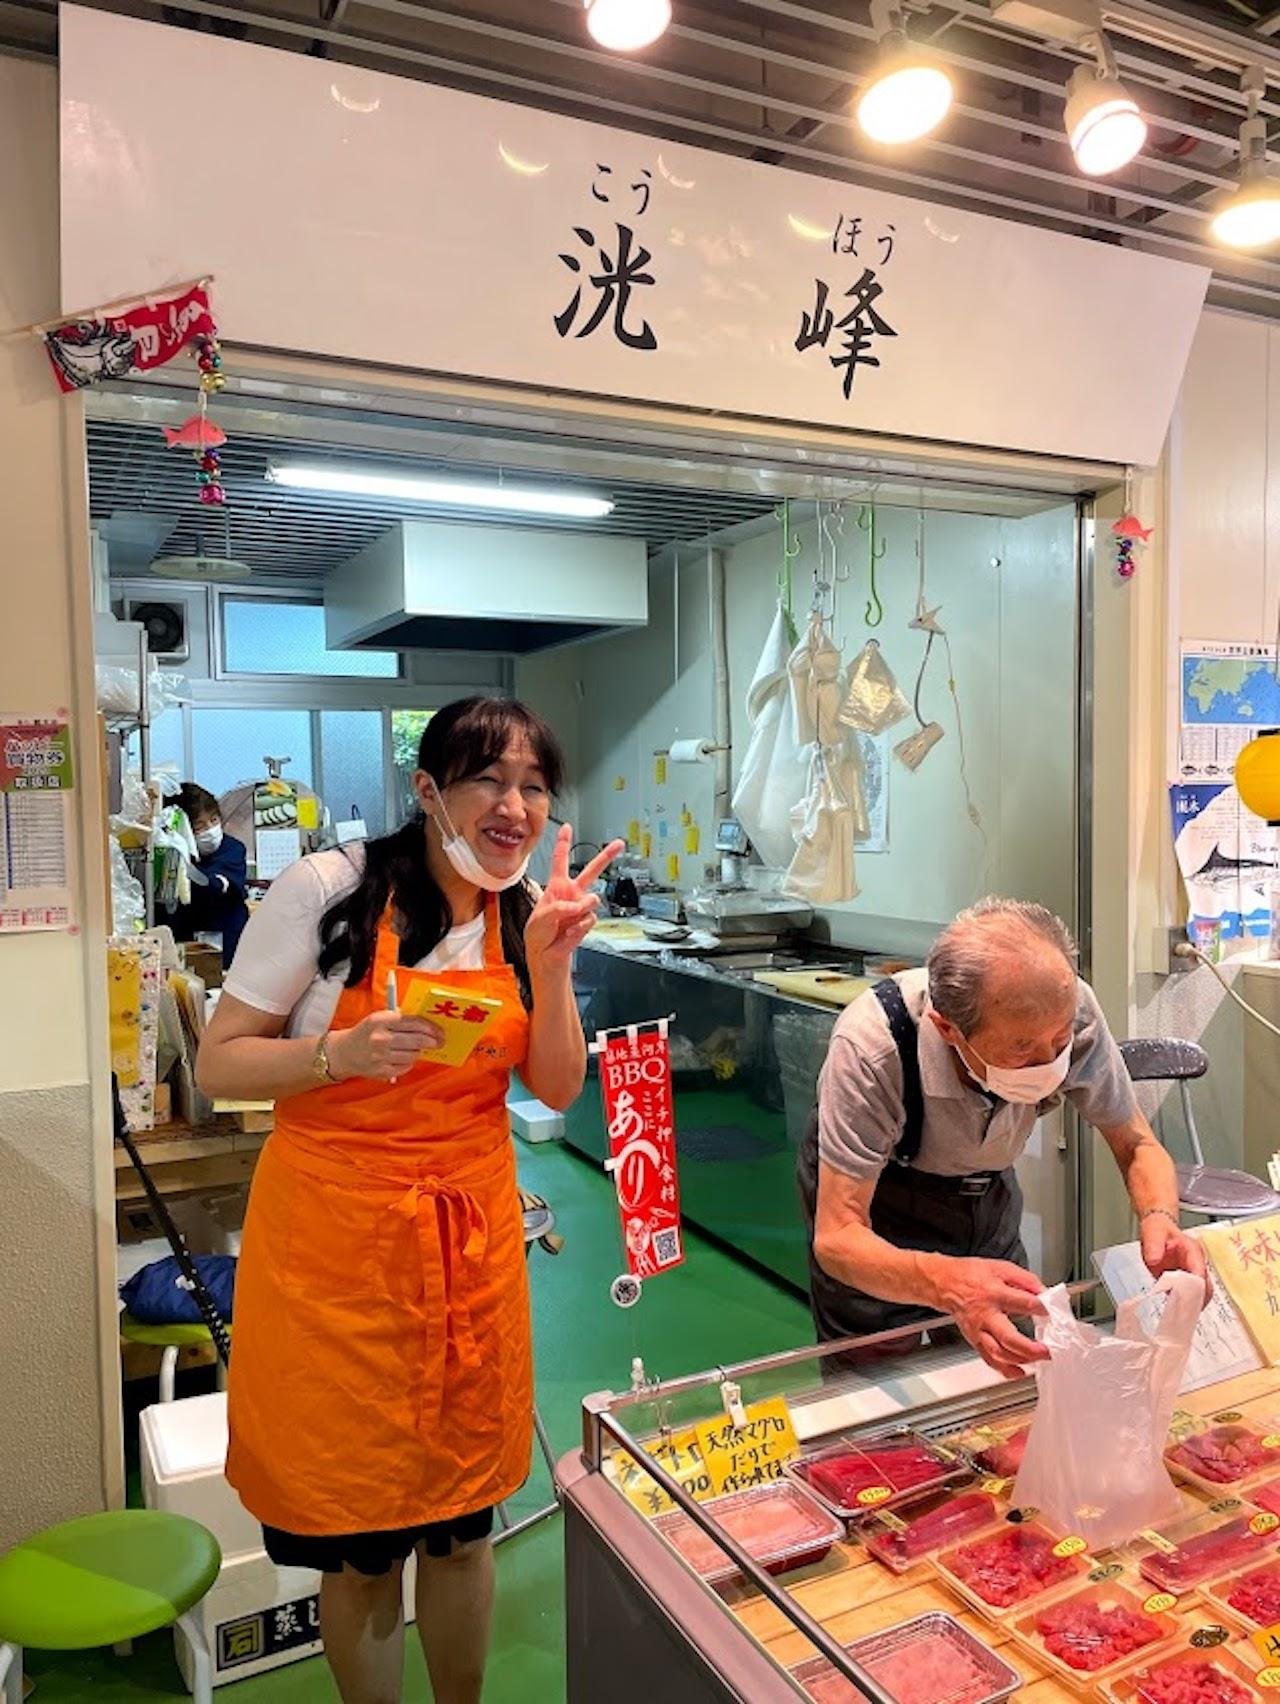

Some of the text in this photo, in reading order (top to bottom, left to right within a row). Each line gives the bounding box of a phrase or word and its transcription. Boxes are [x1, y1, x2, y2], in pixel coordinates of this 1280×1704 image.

[591, 163, 896, 265] こう ほう
[553, 222, 899, 400] 洸 峰
[606, 1057, 666, 1089] BBQ
